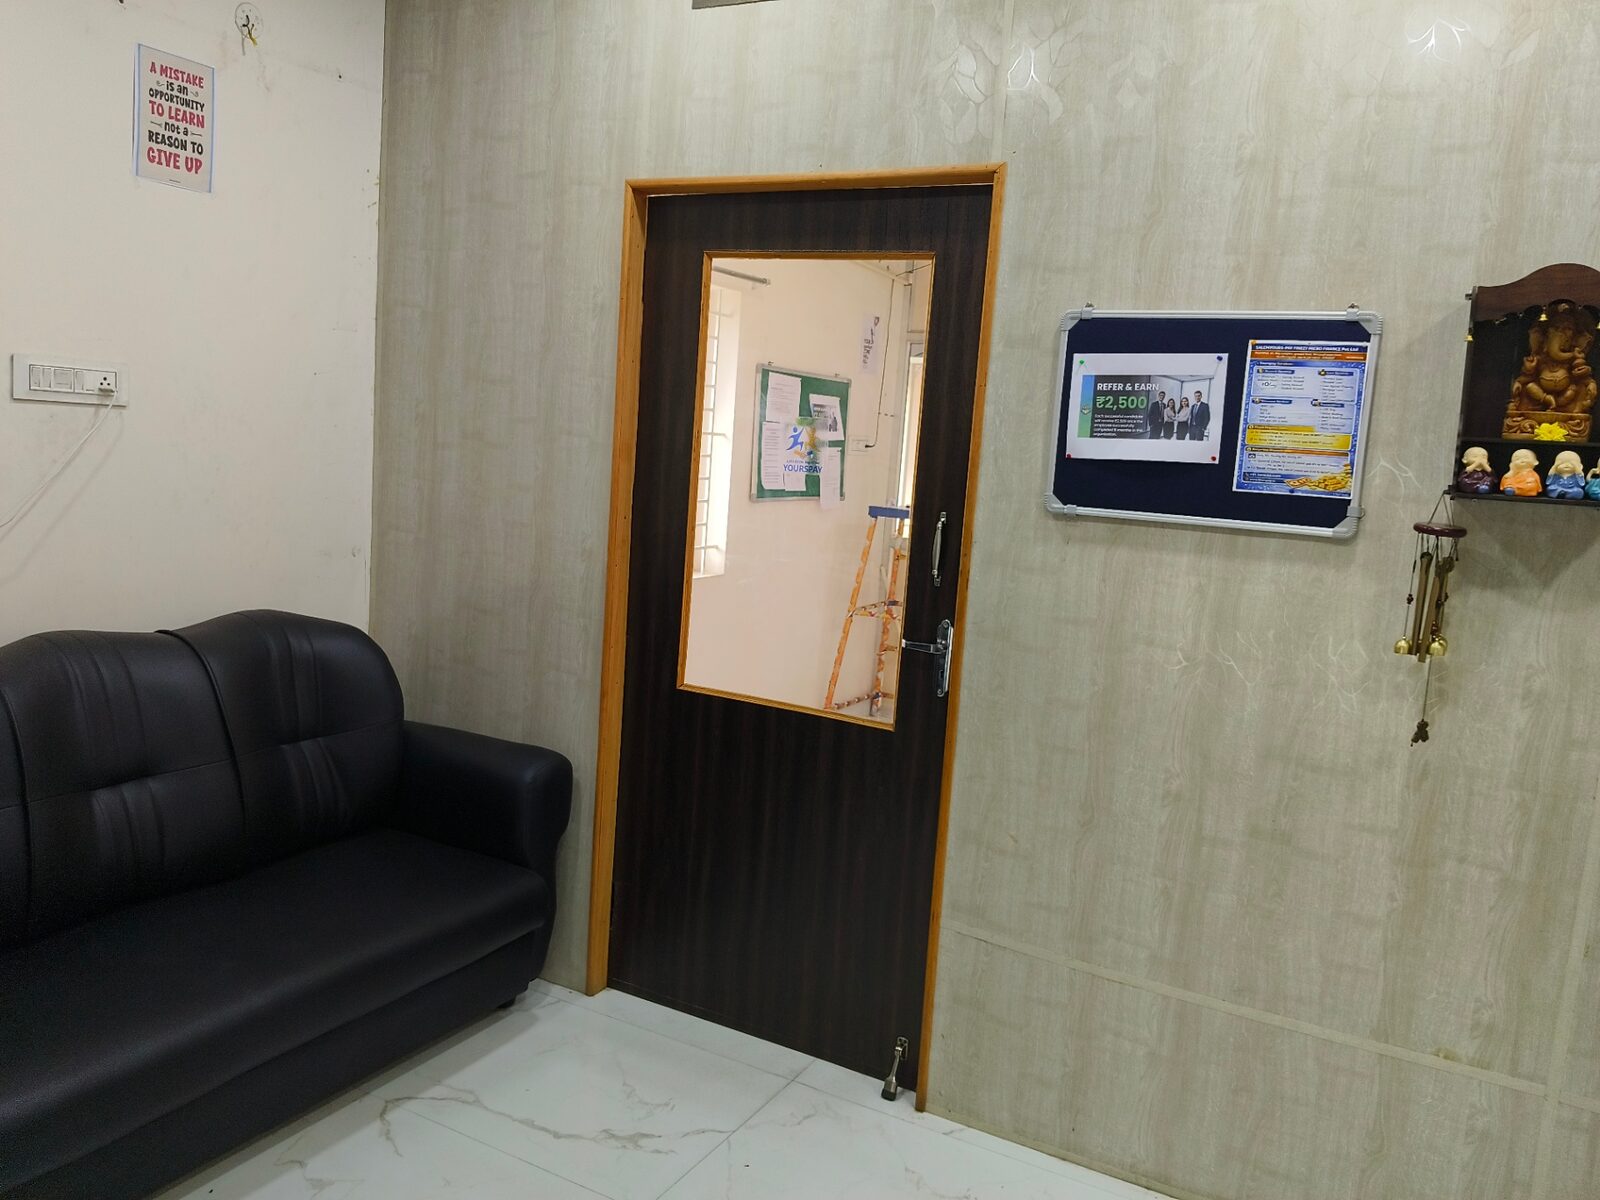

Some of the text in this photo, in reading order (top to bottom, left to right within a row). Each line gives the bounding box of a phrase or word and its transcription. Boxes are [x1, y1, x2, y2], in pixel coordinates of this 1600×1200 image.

[150, 61, 204, 88] A MISTAKE
[166, 80, 188, 96] is an
[148, 88, 205, 112] OPPORTUNITY
[148, 100, 205, 129] TO LEARN
[164, 121, 189, 137] not a
[148, 130, 204, 156] REASON TO
[146, 146, 203, 174] GIVE UP
[1096, 382, 1160, 391] REFER & EARN
[1096, 396, 1147, 410] ₹2,500
[783, 464, 823, 473] YOURSPAY
